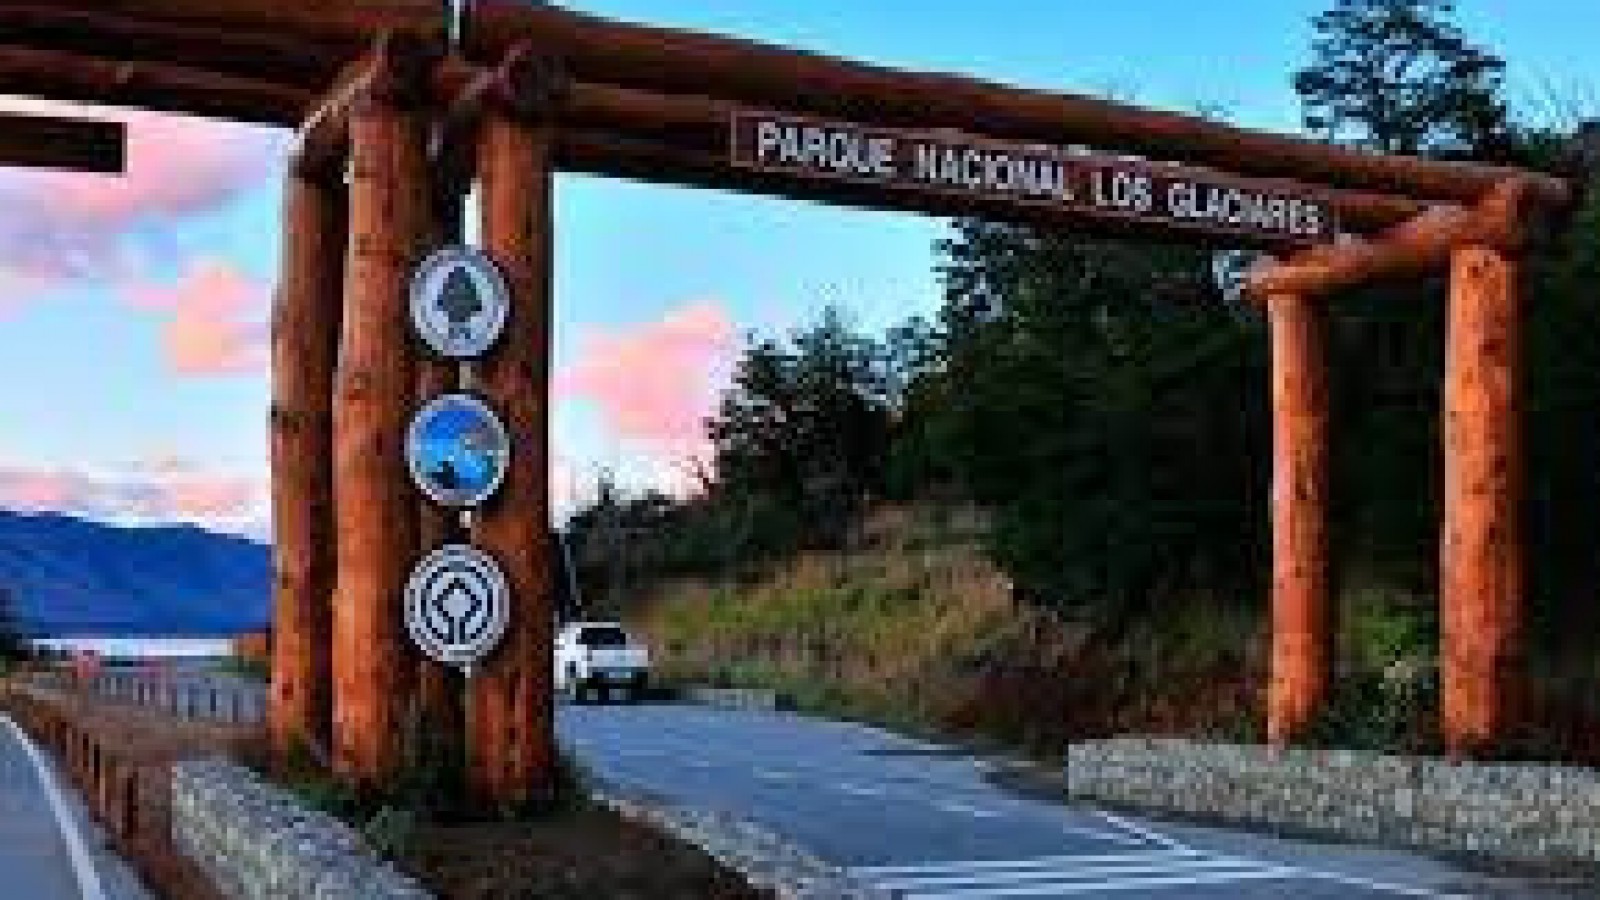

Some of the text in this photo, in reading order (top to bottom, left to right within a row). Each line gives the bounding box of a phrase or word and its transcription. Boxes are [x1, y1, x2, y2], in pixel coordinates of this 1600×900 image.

[756, 121, 1324, 234] PARQUE NACIONAL LOS GLACIARES
